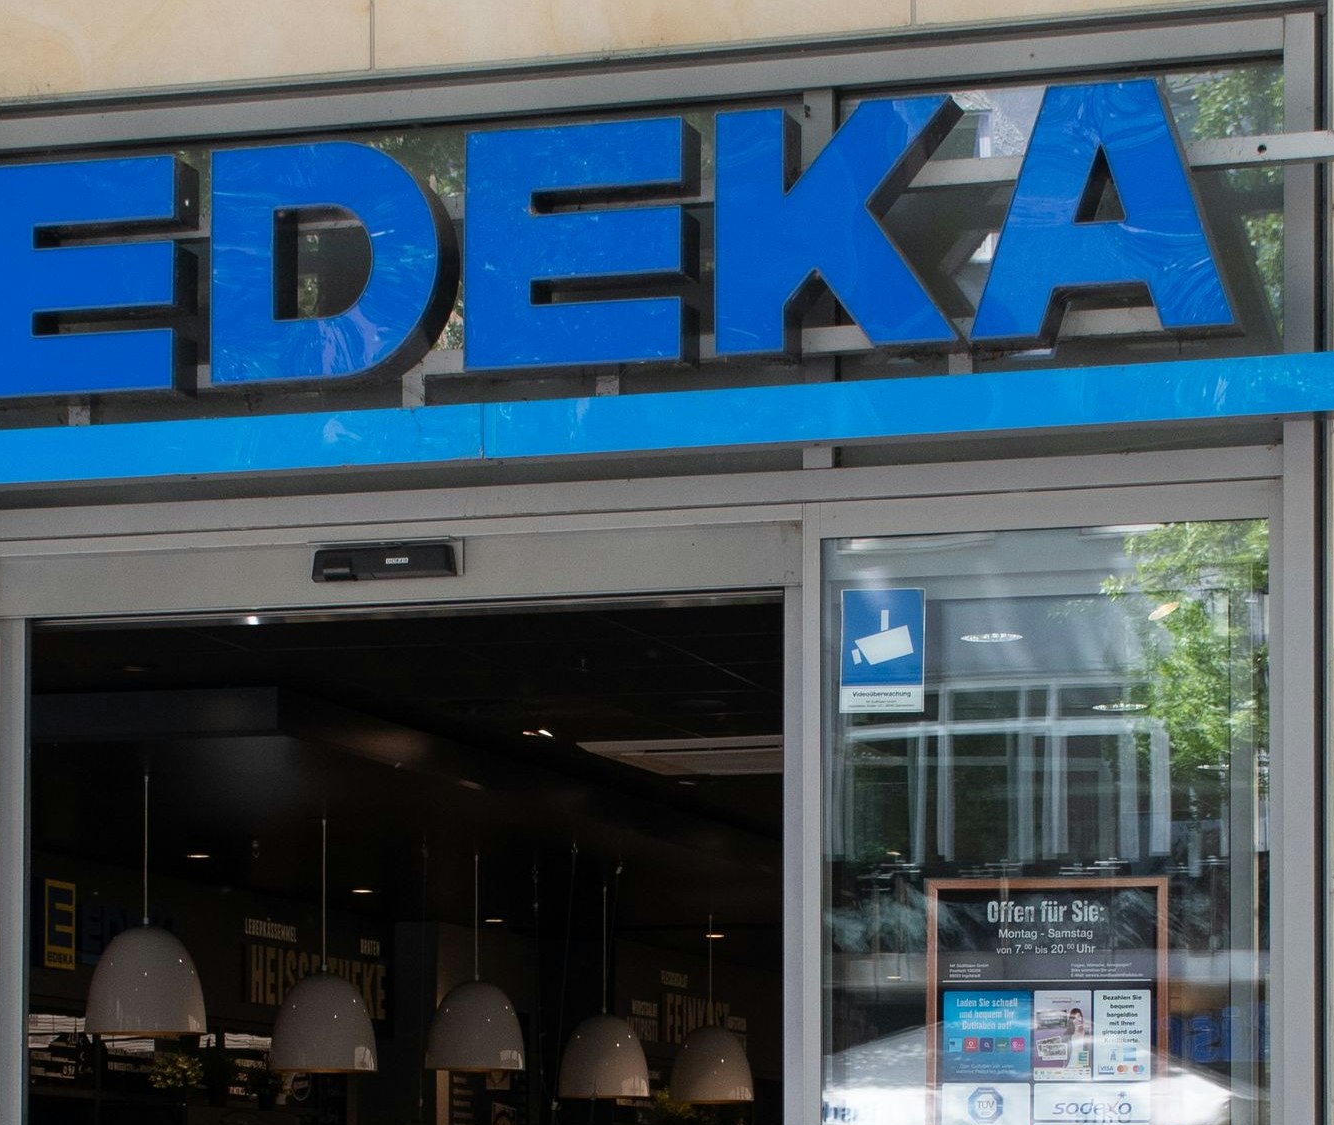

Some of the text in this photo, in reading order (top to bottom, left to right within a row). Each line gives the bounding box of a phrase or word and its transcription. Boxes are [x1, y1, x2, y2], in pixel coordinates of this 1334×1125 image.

[852, 690, 912, 699] Videoüberwachung
[987, 899, 1106, 923] Offen für Sie:
[998, 928, 1094, 941] Montag Samstag
[996, 946, 1012, 954] von
[1035, 945, 1048, 954] bis
[1076, 944, 1097, 954] Uhr
[956, 998, 1018, 1007] Laden Sie schnell
[959, 1010, 1015, 1020] und bequem Ihr
[962, 1021, 996, 1030] Guthaben
[977, 1099, 995, 1109] TÜV
[1053, 1097, 1132, 1115] sodexo
